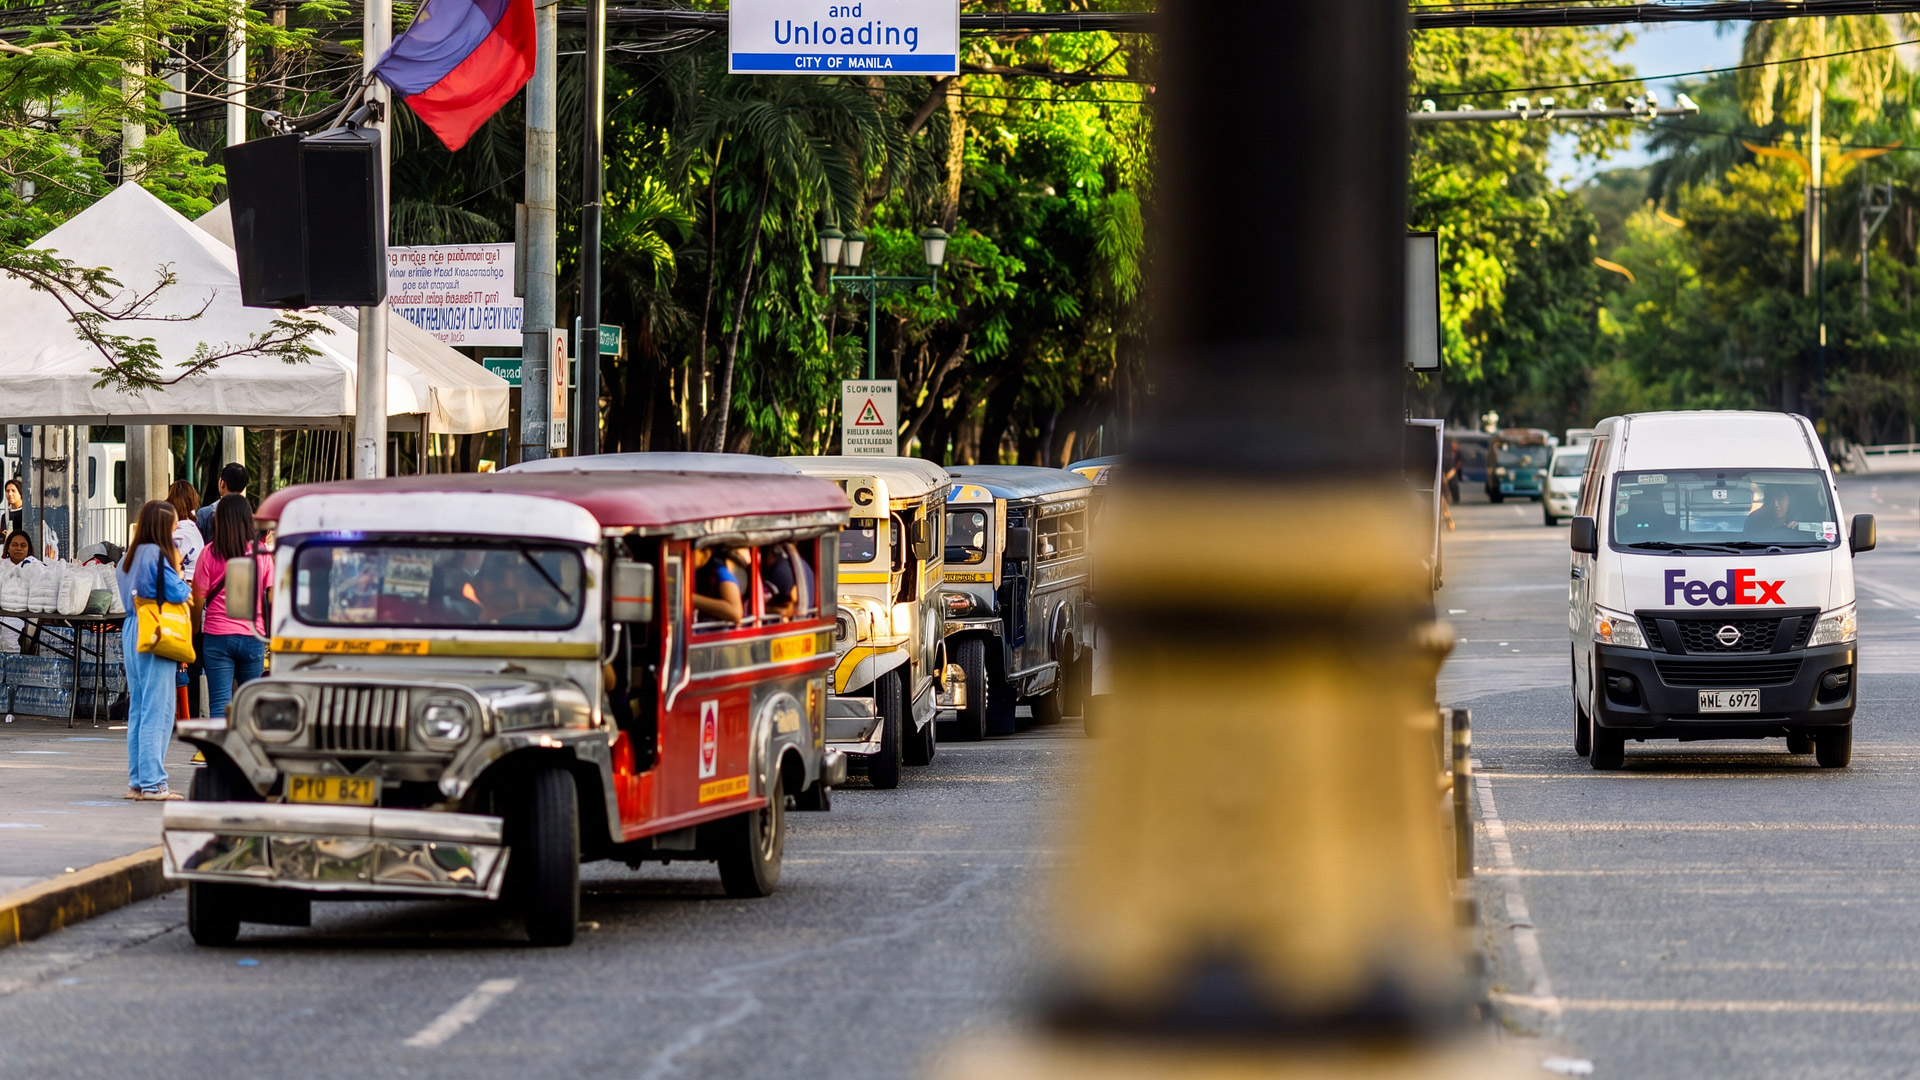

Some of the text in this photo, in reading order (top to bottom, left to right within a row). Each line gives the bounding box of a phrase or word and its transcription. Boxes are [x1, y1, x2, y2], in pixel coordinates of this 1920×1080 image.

[829, 2, 862, 18] and
[774, 20, 919, 52] Unloading
[795, 56, 893, 69] CITY OF MANILA
[846, 385, 893, 394] SLOW DOWN
[1664, 568, 1787, 606] FedEx
[1728, 693, 1758, 708] 6972
